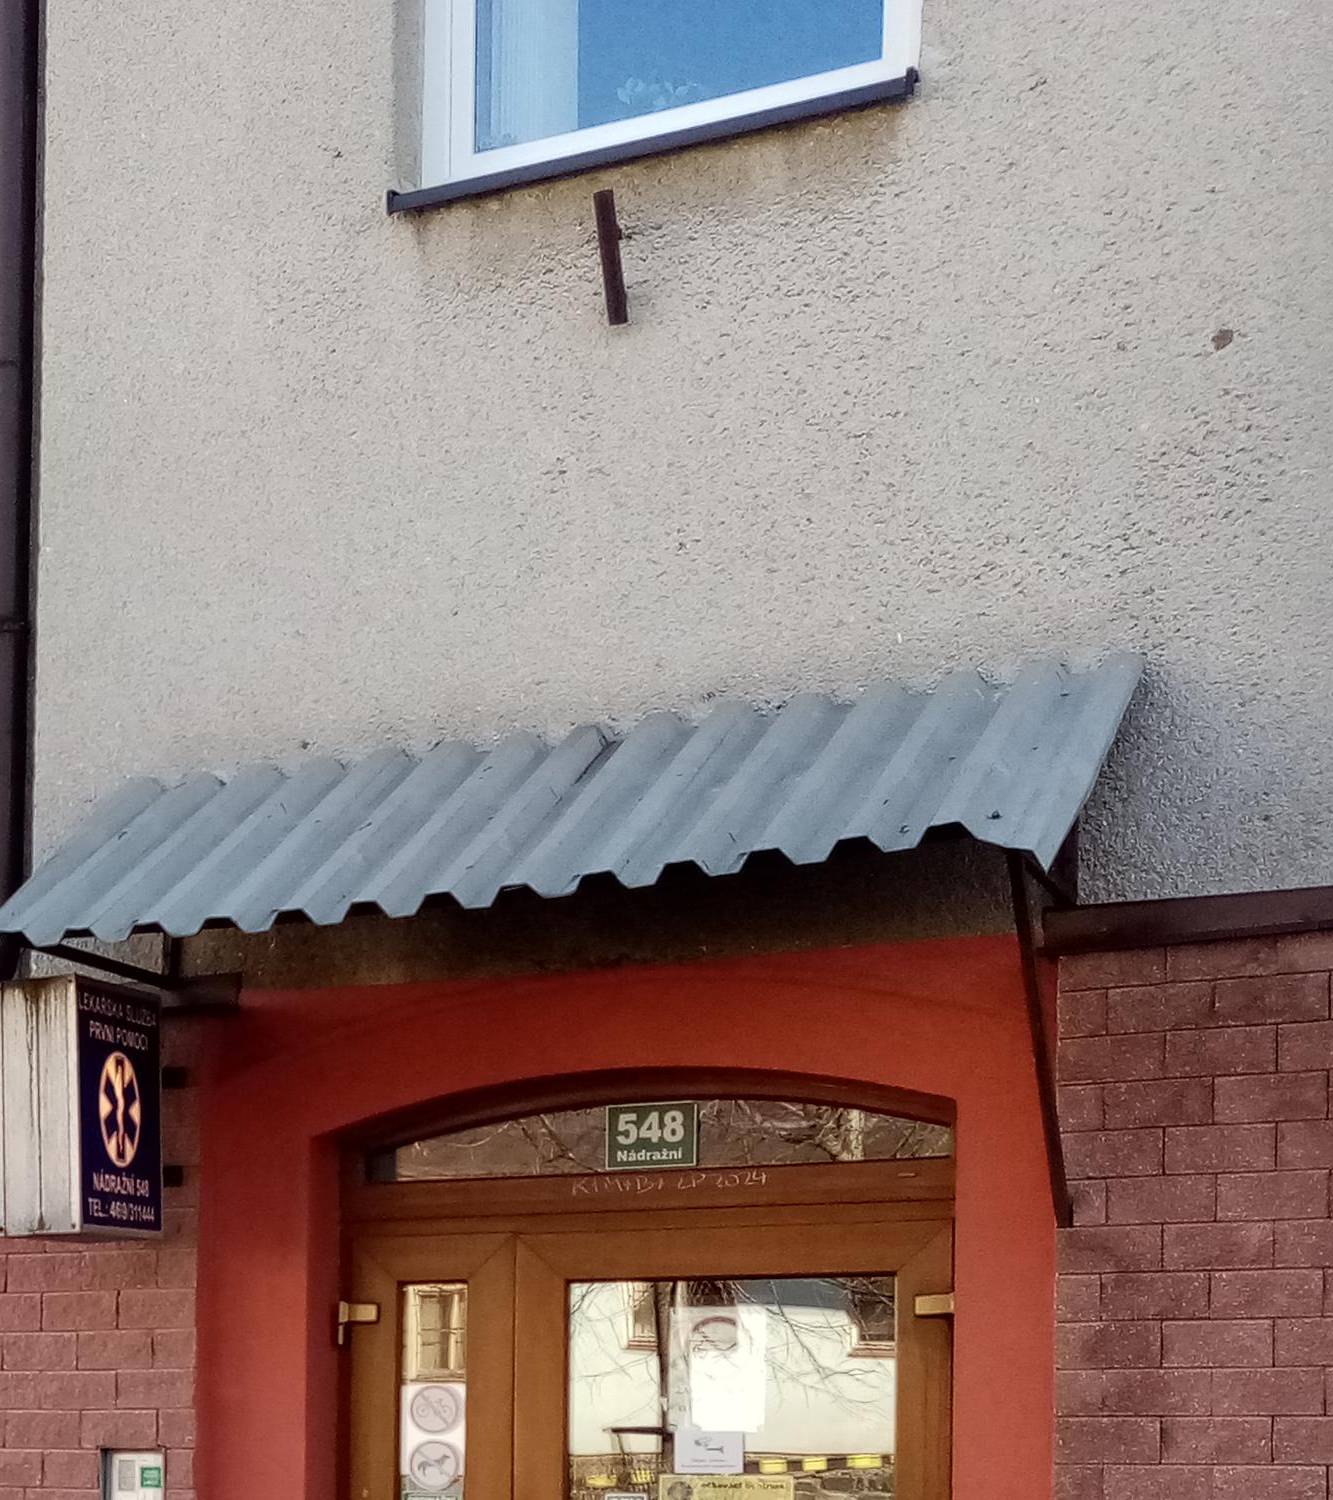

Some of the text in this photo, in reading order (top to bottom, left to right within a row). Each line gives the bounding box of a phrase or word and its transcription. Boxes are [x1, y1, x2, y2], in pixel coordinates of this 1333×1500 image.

[616, 1110, 684, 1146] 548
[616, 1146, 683, 1163] Nádražní
[716, 1170, 767, 1188] 2024
